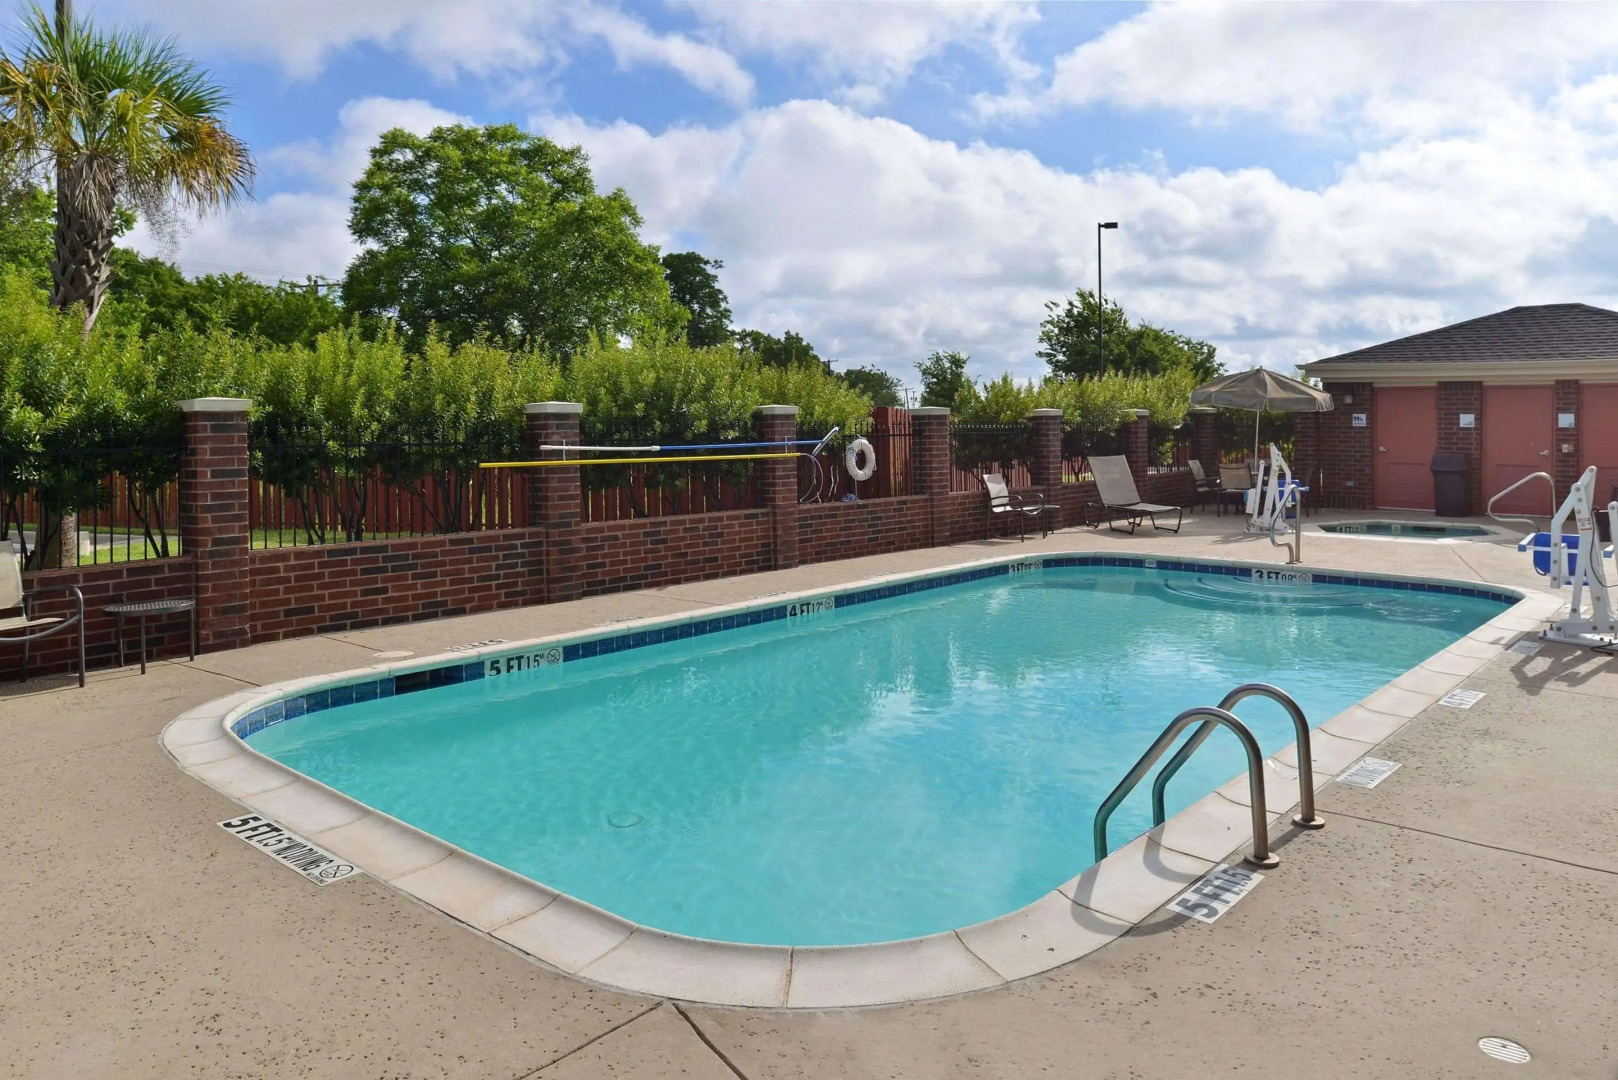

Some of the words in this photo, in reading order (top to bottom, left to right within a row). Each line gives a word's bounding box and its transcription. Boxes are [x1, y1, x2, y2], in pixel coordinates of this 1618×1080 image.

[1267, 571, 1280, 580] FT
[789, 604, 798, 617] 4
[800, 602, 811, 615] FT
[489, 659, 502, 677] 5
[506, 655, 524, 673] FT
[222, 815, 263, 829] 5
[1175, 897, 1219, 920] 5
